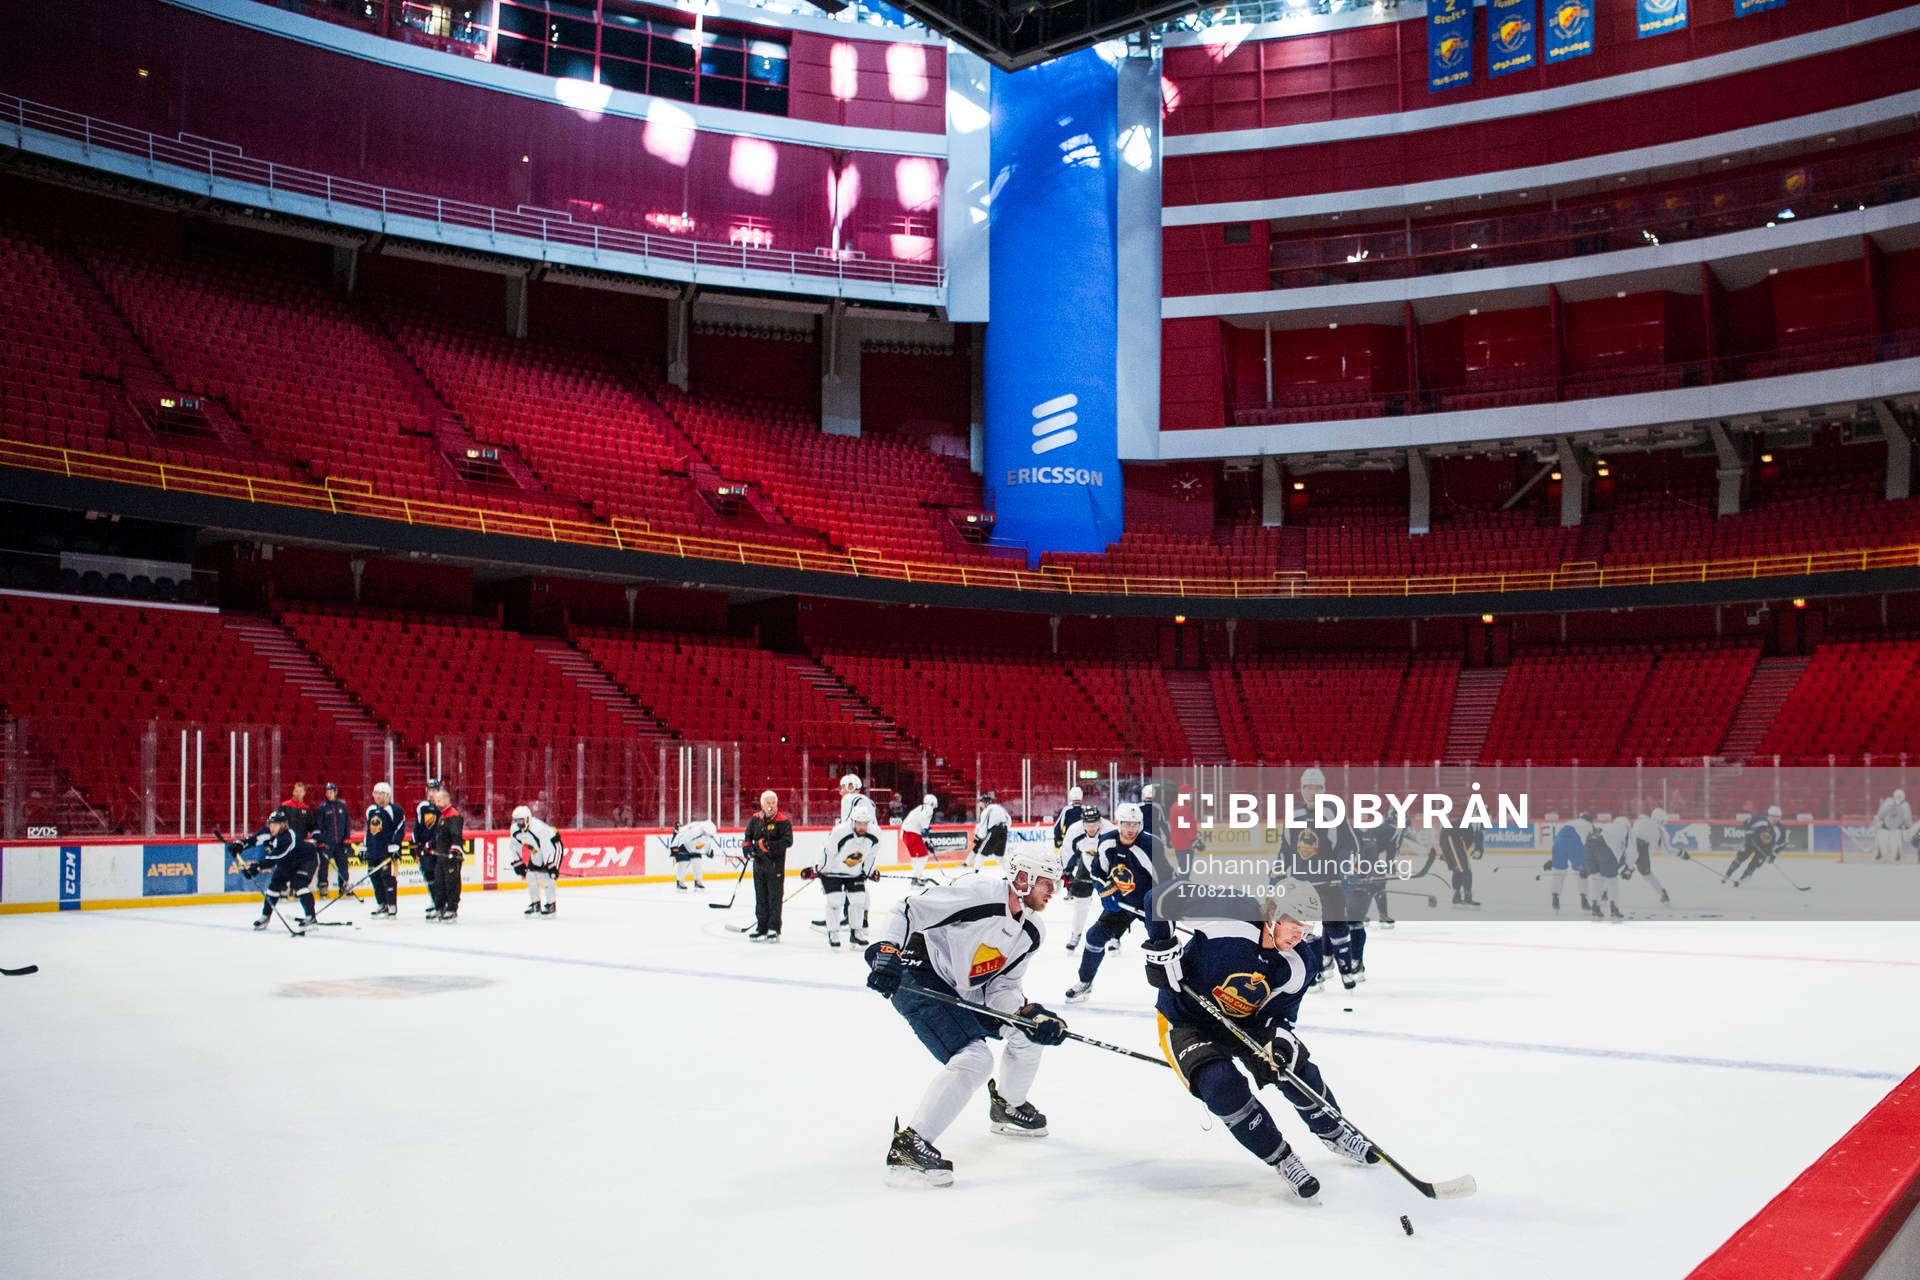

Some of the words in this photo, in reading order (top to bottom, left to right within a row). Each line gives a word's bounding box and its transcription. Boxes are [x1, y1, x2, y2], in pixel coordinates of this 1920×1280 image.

[1007, 467, 1103, 487] ERICSSON
[486, 842, 495, 878] CCM
[563, 846, 634, 869] CM
[65, 851, 77, 895] CCM
[147, 862, 194, 877] AREPA
[1146, 949, 1182, 962] CCM
[1220, 993, 1233, 1005] PRO
